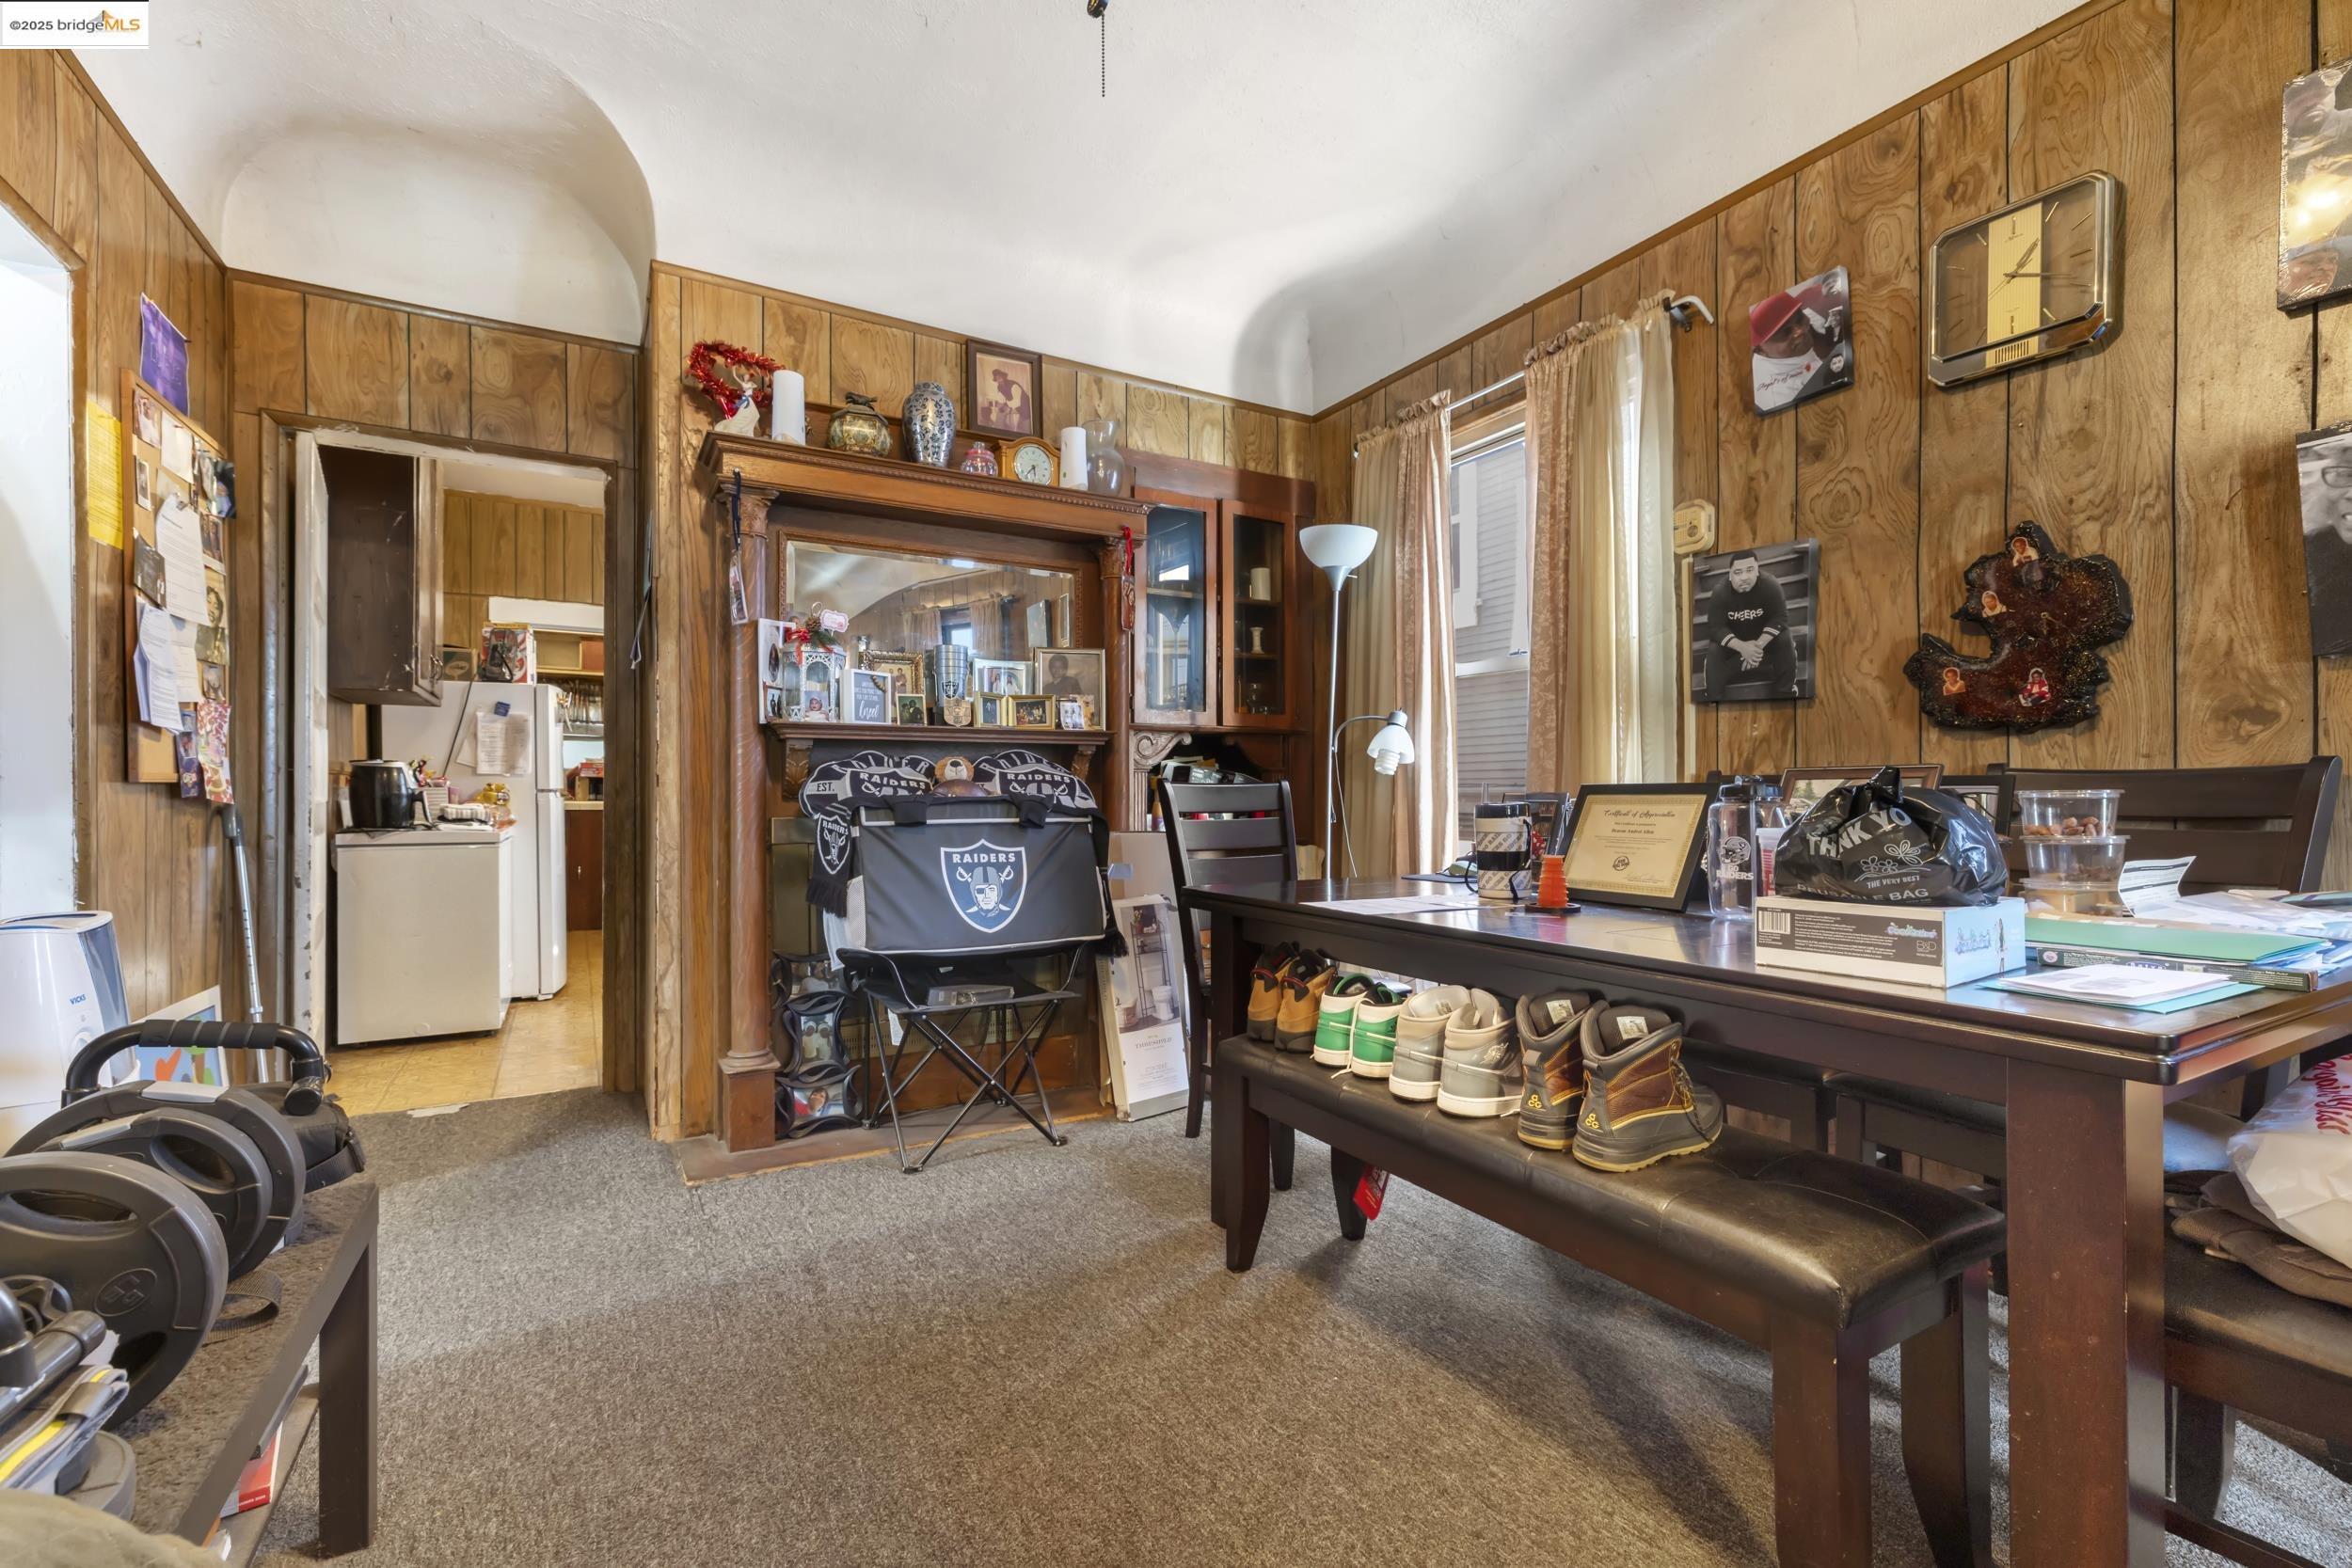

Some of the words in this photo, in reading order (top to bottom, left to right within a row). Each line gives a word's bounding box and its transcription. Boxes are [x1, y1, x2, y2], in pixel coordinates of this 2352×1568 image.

[859, 772, 926, 790] RAIDERS
[1007, 773, 1071, 783] RAIDERS
[817, 782, 835, 792] EST.
[822, 819, 849, 835] RAIDERS
[1806, 820, 1872, 858] THNK
[952, 852, 1016, 863] RAIDERS
[1716, 869, 1754, 880] RAIDERS
[1867, 879, 1881, 889] THE
[1882, 878, 1900, 886] VERY
[1889, 888, 1929, 900] BAG
[70, 993, 87, 1005] VICKS
